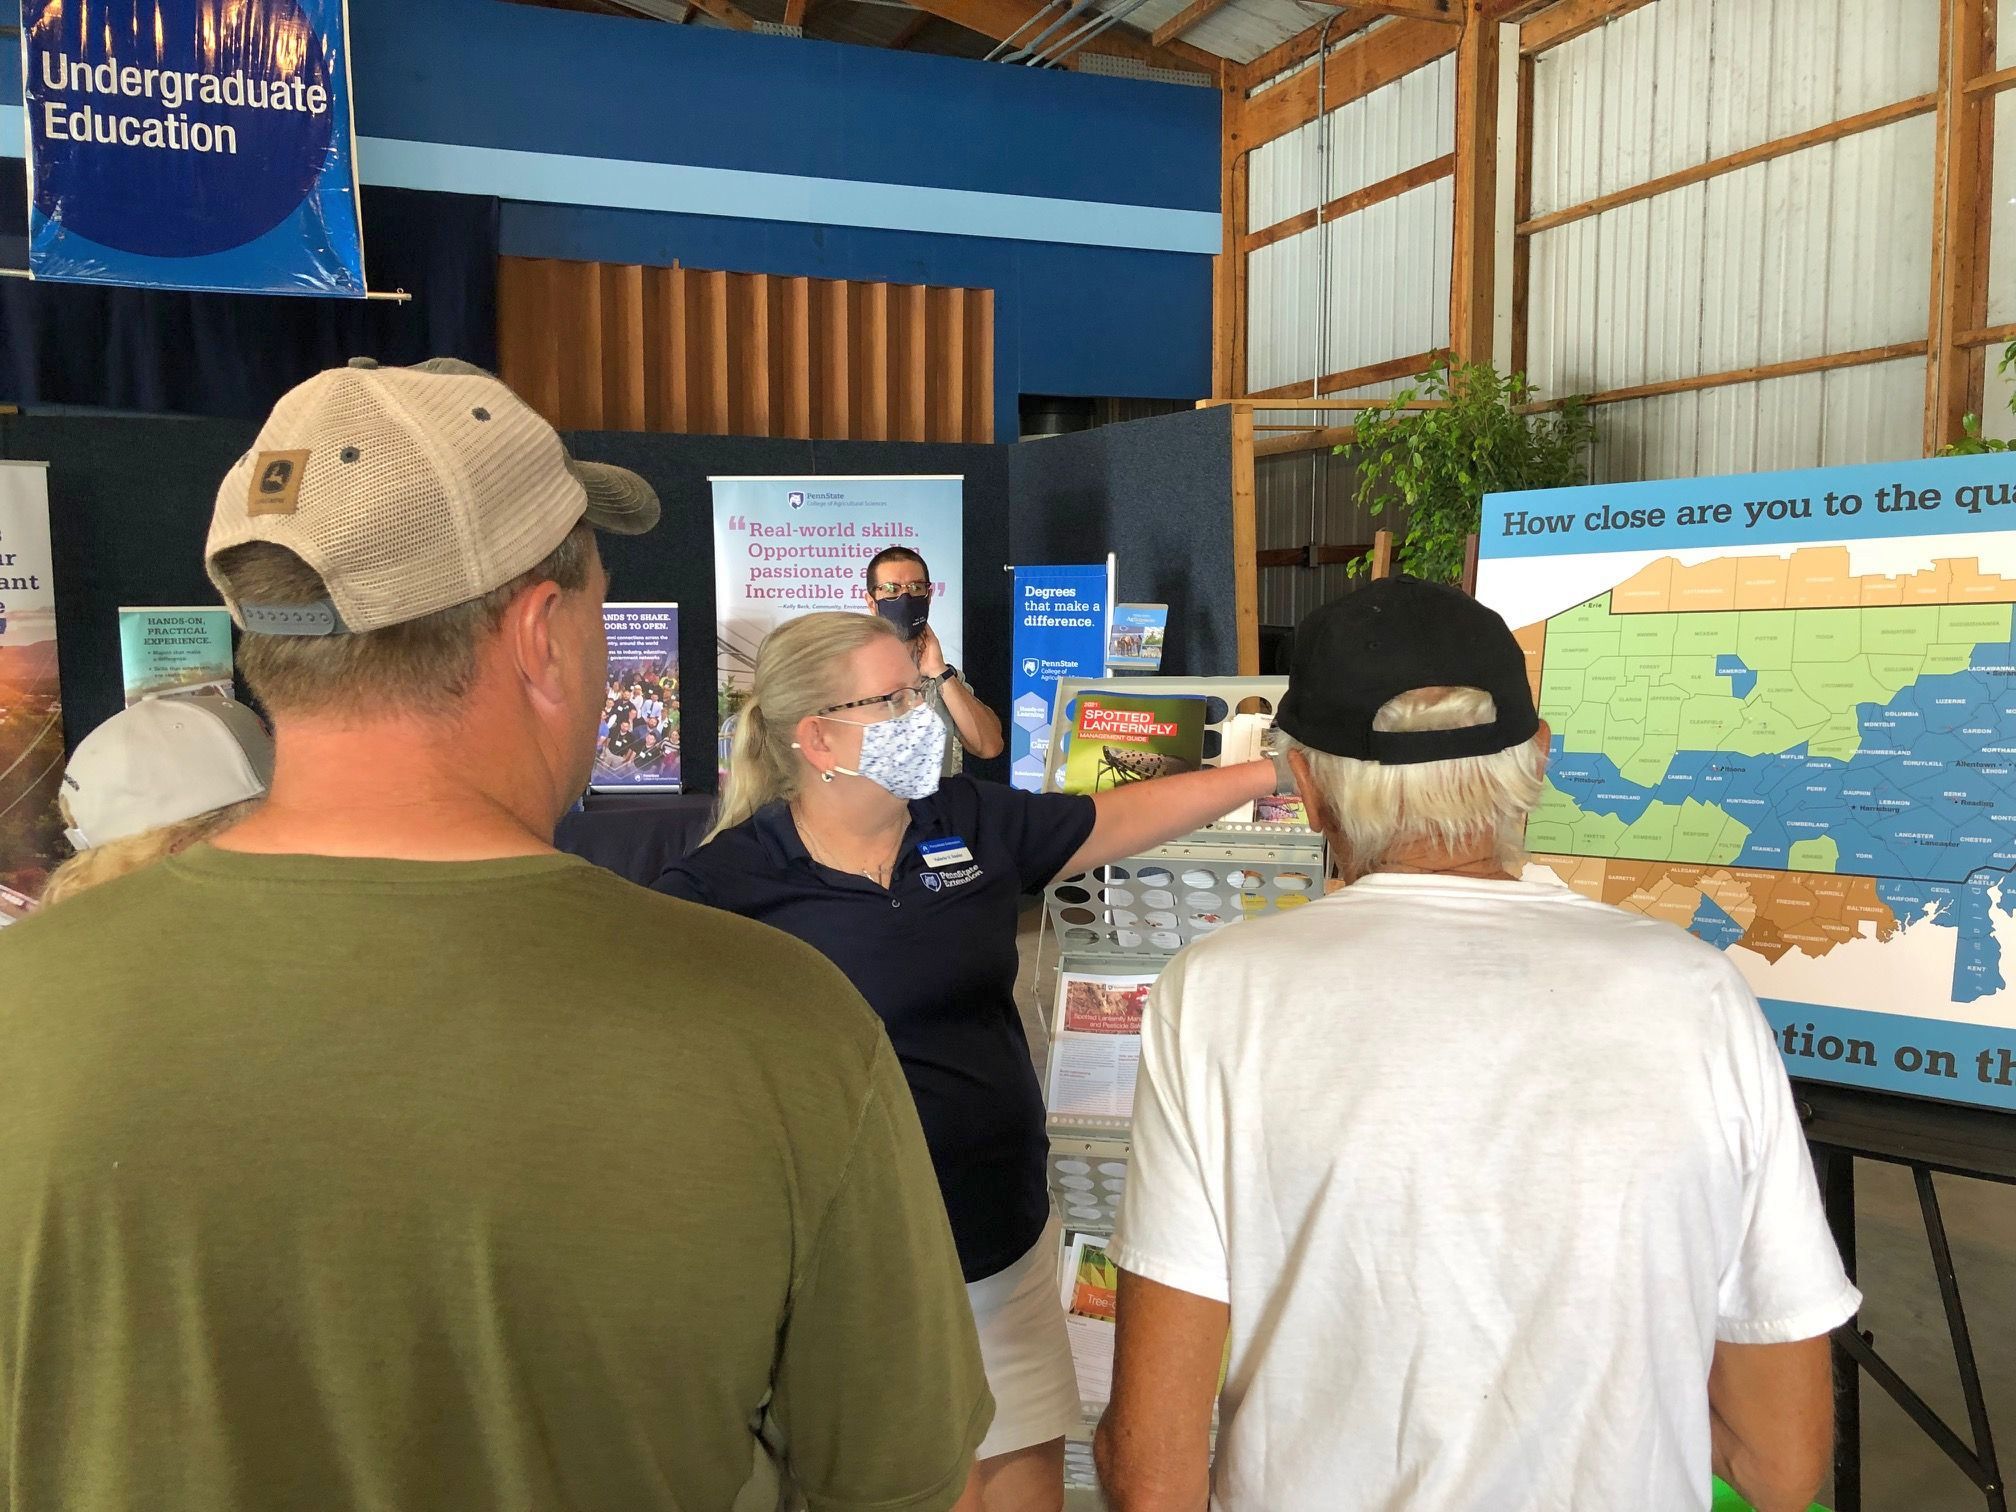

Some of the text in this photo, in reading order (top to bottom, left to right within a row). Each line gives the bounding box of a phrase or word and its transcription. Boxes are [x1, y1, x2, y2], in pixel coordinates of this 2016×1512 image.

[41, 50, 328, 115] Undergraduate
[44, 102, 238, 155] Education
[1502, 511, 1576, 536] How
[1584, 505, 1666, 531] close
[1676, 503, 1732, 526] are
[1743, 498, 1812, 528] you
[1824, 492, 1863, 516] to
[1875, 484, 1942, 513] the
[862, 522, 919, 537] skills.
[749, 564, 854, 582] passionate
[745, 584, 844, 599] Incredible
[1024, 586, 1077, 600] Degrees
[1024, 600, 1101, 612] that make a
[603, 613, 671, 621] ANDS TO SHAKE.
[1024, 614, 1095, 628] difference.
[604, 622, 669, 630] OORS TO OPEN.
[147, 627, 208, 636] PRACTICAL
[143, 637, 212, 646] EXPERIENCE.
[1041, 660, 1079, 668] PennState
[1041, 668, 1062, 676] College
[1084, 710, 1151, 723] SPOTTED
[1083, 721, 1174, 735] LANTERNFLY
[1080, 733, 1126, 741] MANAGEMENT
[1955, 759, 1997, 768] Allentown
[1859, 804, 1900, 813] Harrisburg
[1960, 800, 1995, 808] Reading
[1919, 840, 1960, 848] Lancaster
[1959, 836, 1992, 844] CHESTER
[939, 864, 980, 879] PennState
[1735, 872, 1775, 880] WASHINGTON
[943, 870, 984, 888] Extension
[1814, 889, 1844, 897] CARROLL
[1783, 934, 1829, 943] MONTGOMERY
[1751, 941, 1782, 949] LOUDOUN
[1894, 1045, 1959, 1078] on
